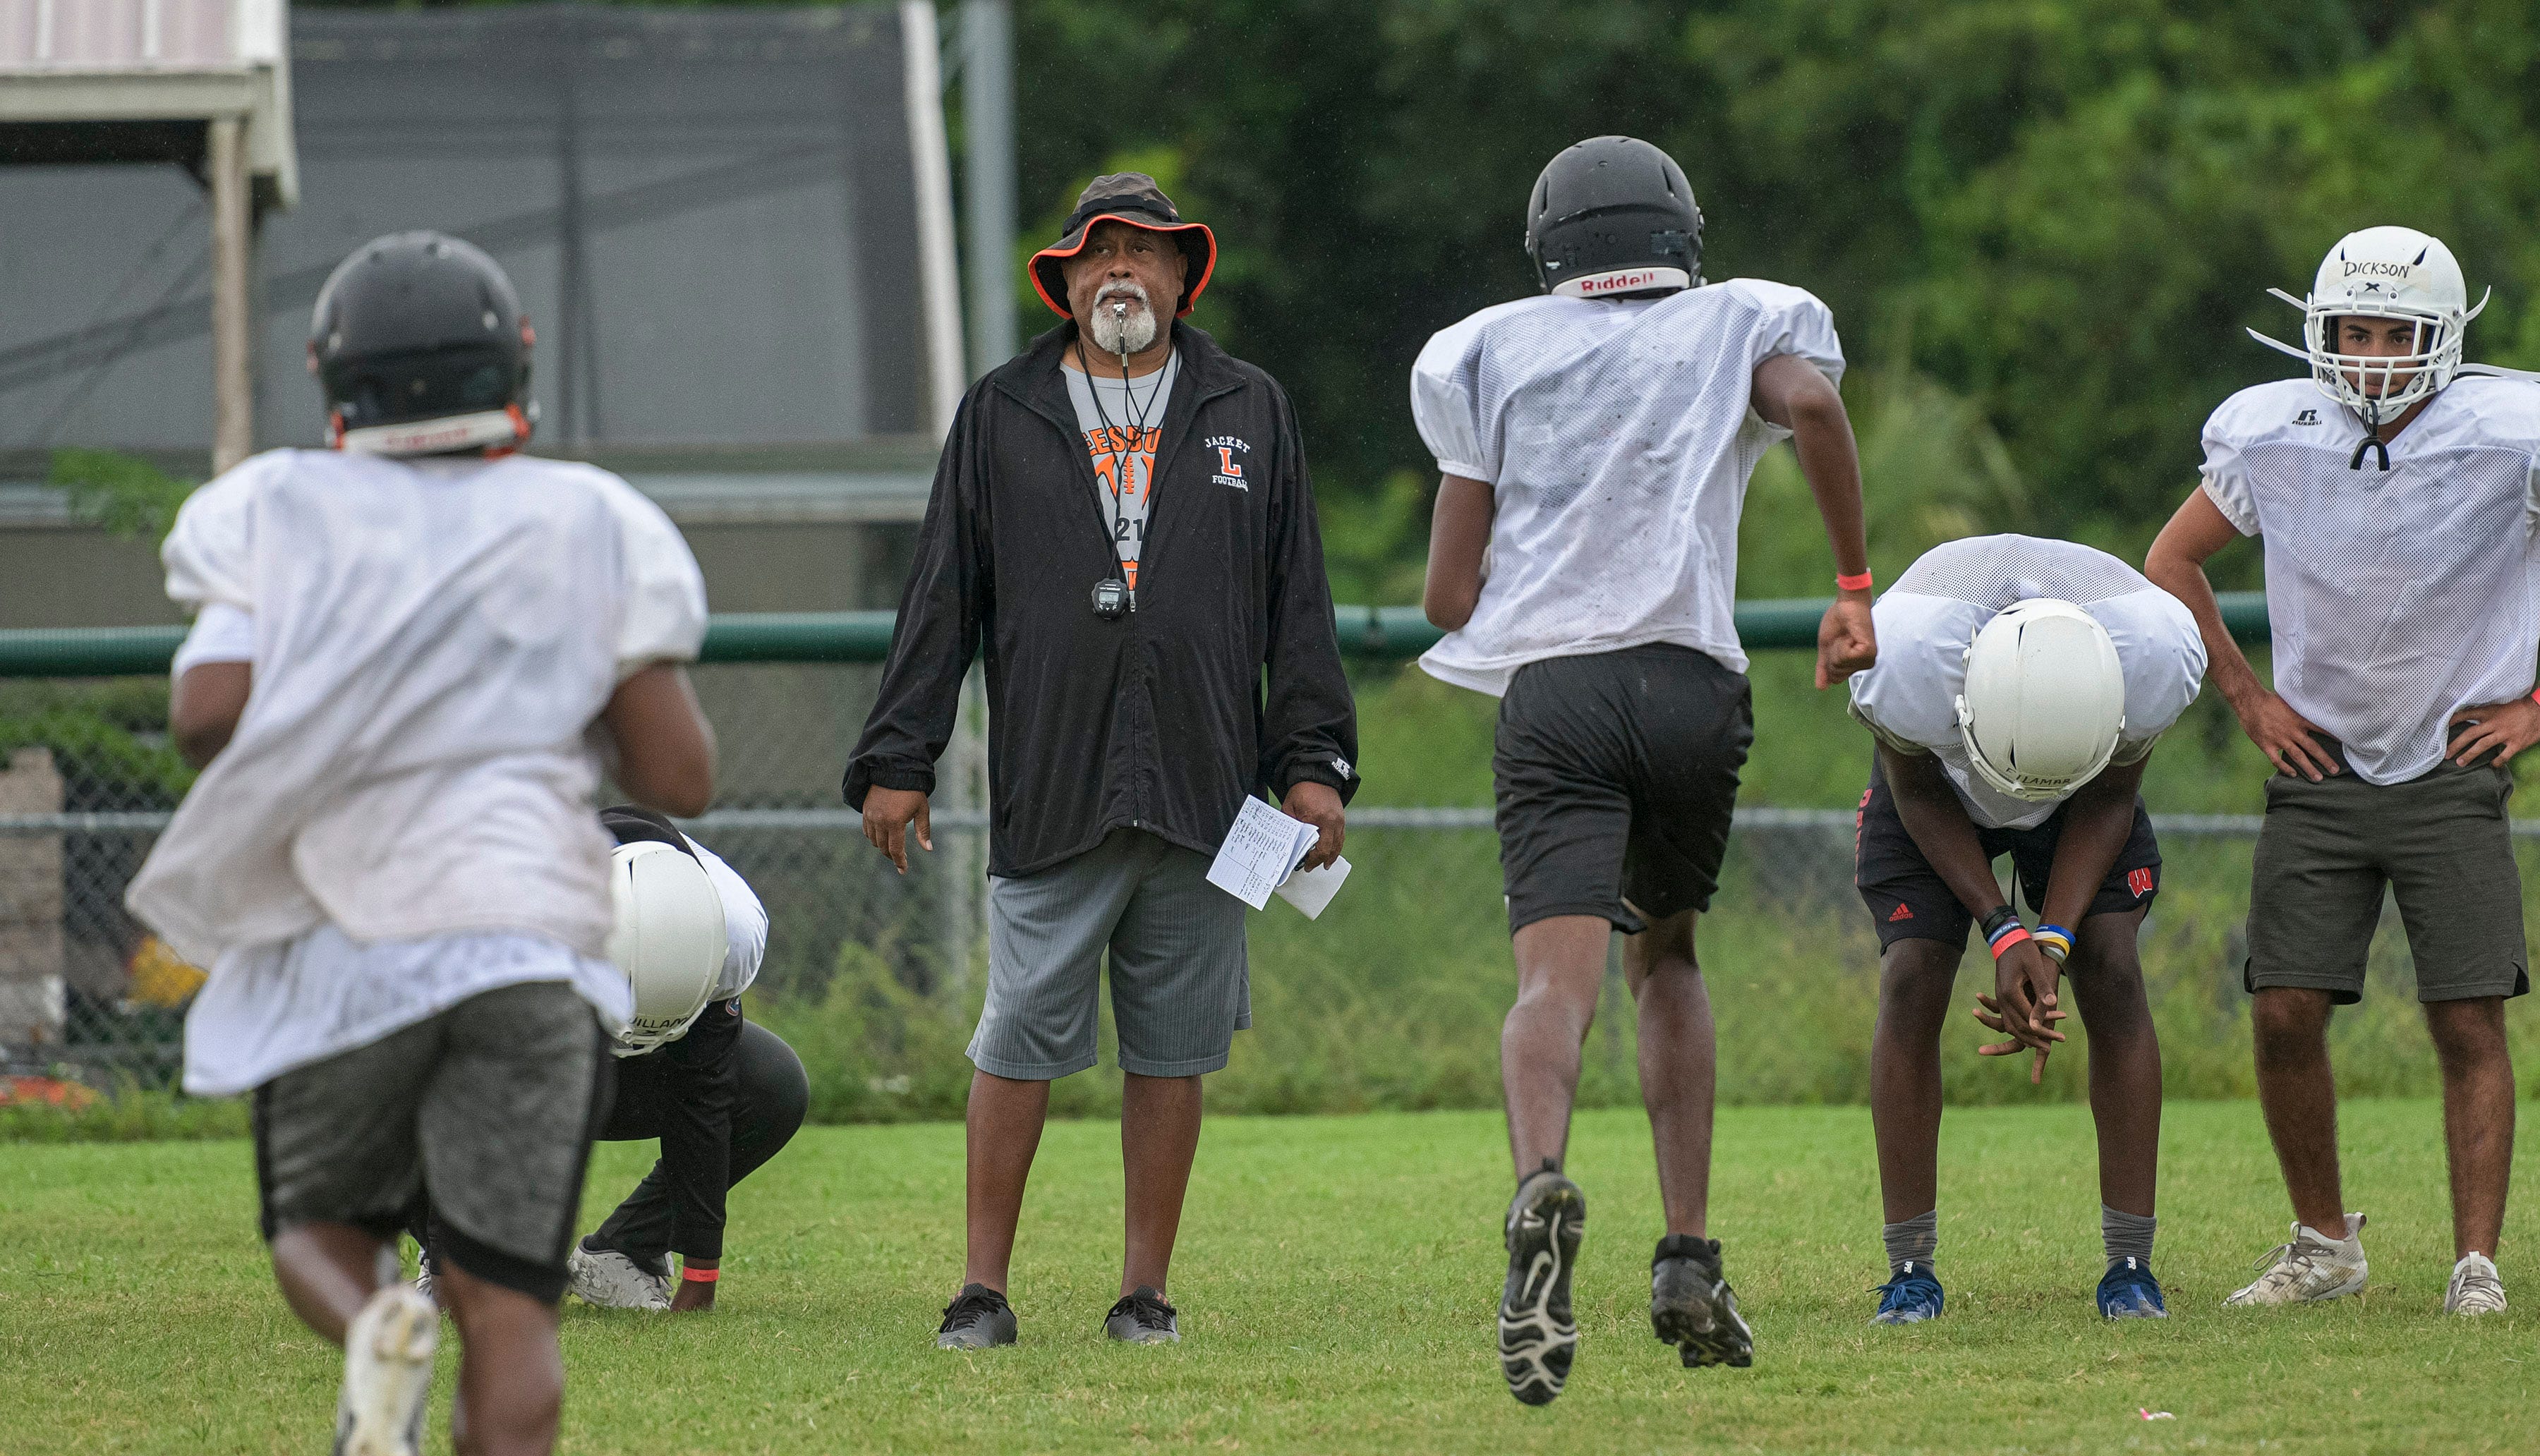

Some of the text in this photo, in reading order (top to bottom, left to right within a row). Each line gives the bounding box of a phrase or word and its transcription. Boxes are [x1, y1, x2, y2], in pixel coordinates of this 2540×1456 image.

[2344, 262, 2409, 279] DICKSON
[1580, 272, 1655, 291] Riddell
[1204, 436, 1251, 454] JACKET
[1218, 447, 1242, 478] L
[2127, 867, 2154, 899] W
[1889, 911, 1913, 922] adidas
